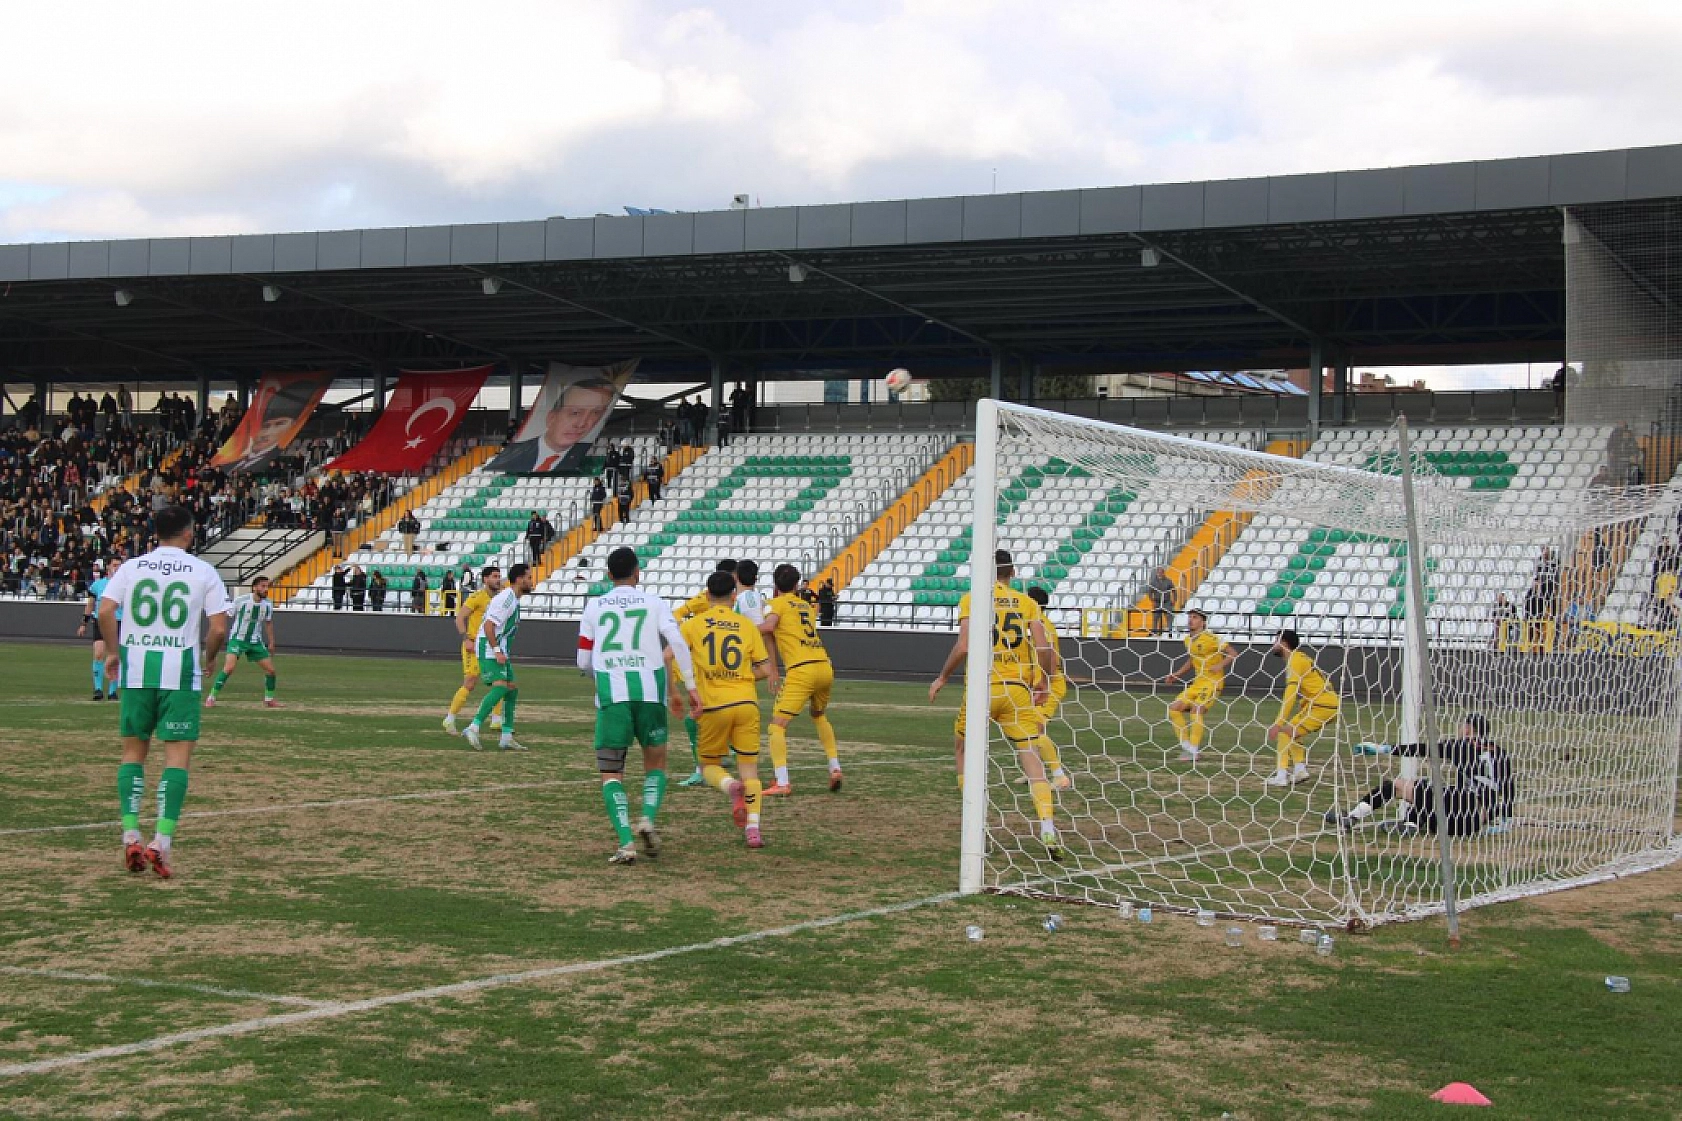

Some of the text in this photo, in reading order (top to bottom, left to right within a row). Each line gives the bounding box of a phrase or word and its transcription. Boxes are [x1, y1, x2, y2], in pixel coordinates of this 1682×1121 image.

[137, 560, 193, 575] Polgün
[131, 578, 190, 629] 66
[598, 596, 646, 608] Polgün
[598, 608, 648, 652] 27
[799, 612, 816, 638] 5
[702, 631, 742, 670] 16
